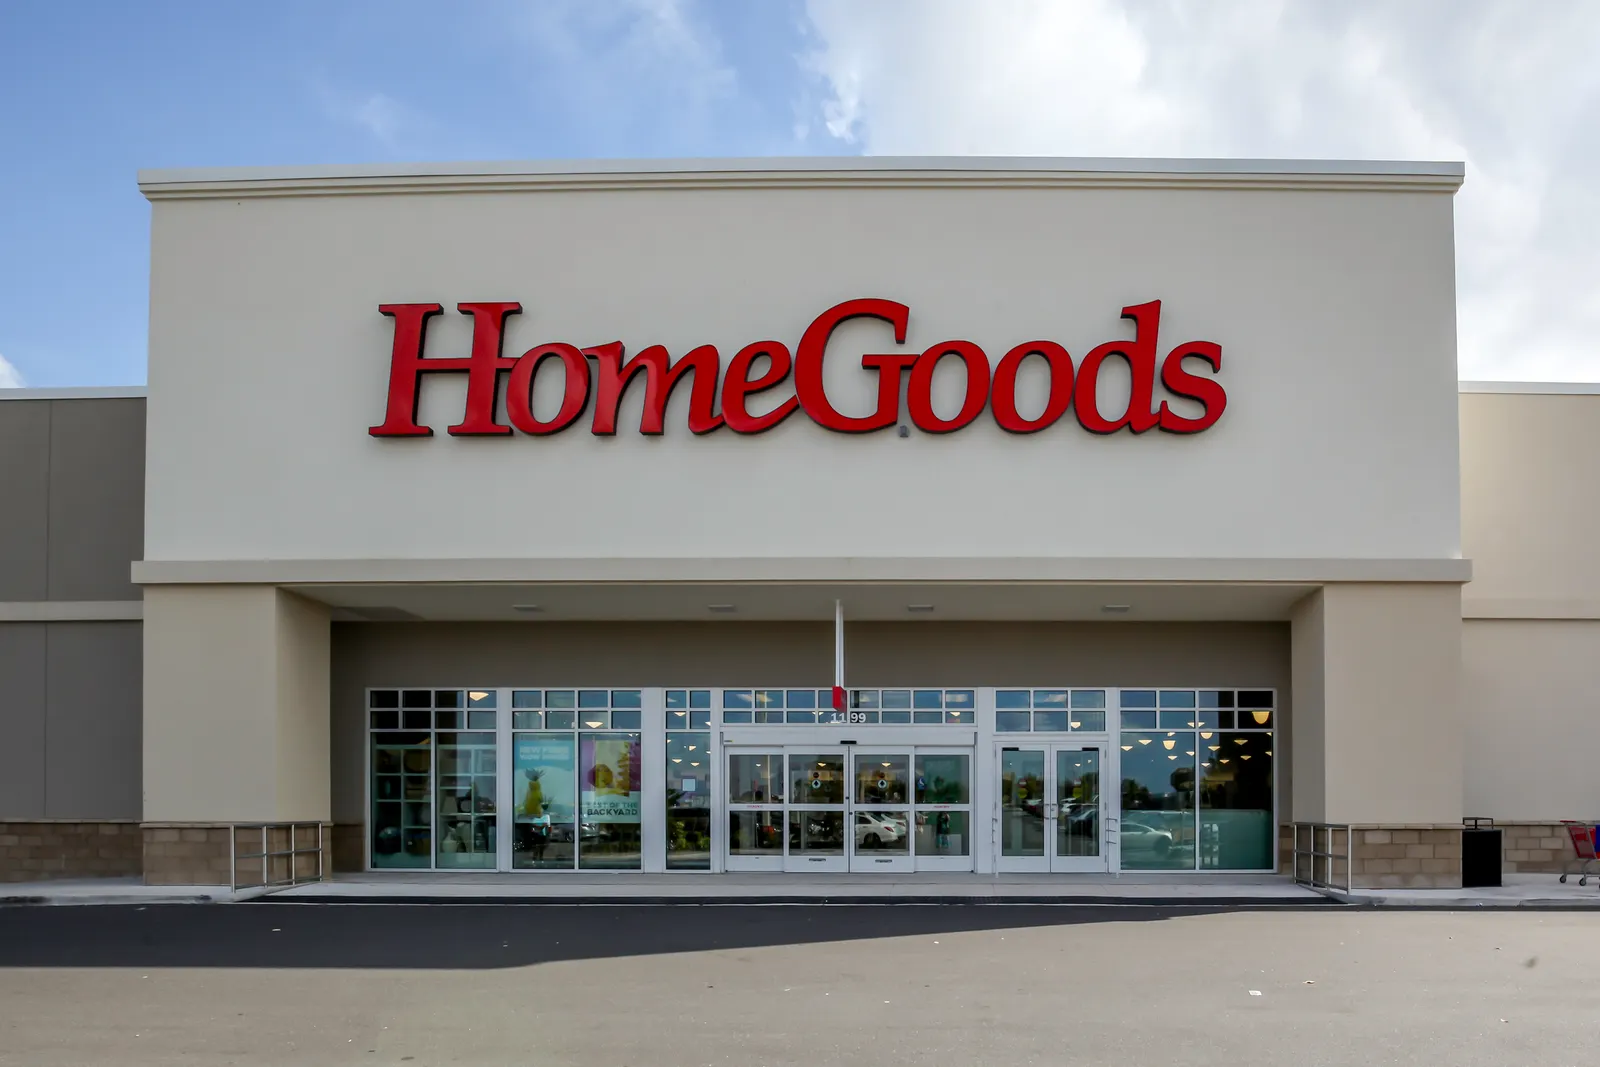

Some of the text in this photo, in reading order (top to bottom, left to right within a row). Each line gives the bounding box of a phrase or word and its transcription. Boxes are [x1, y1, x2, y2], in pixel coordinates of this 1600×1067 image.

[368, 298, 1227, 437] HomeGoods
[831, 713, 866, 723] 1199
[587, 808, 638, 816] BACKYARD
